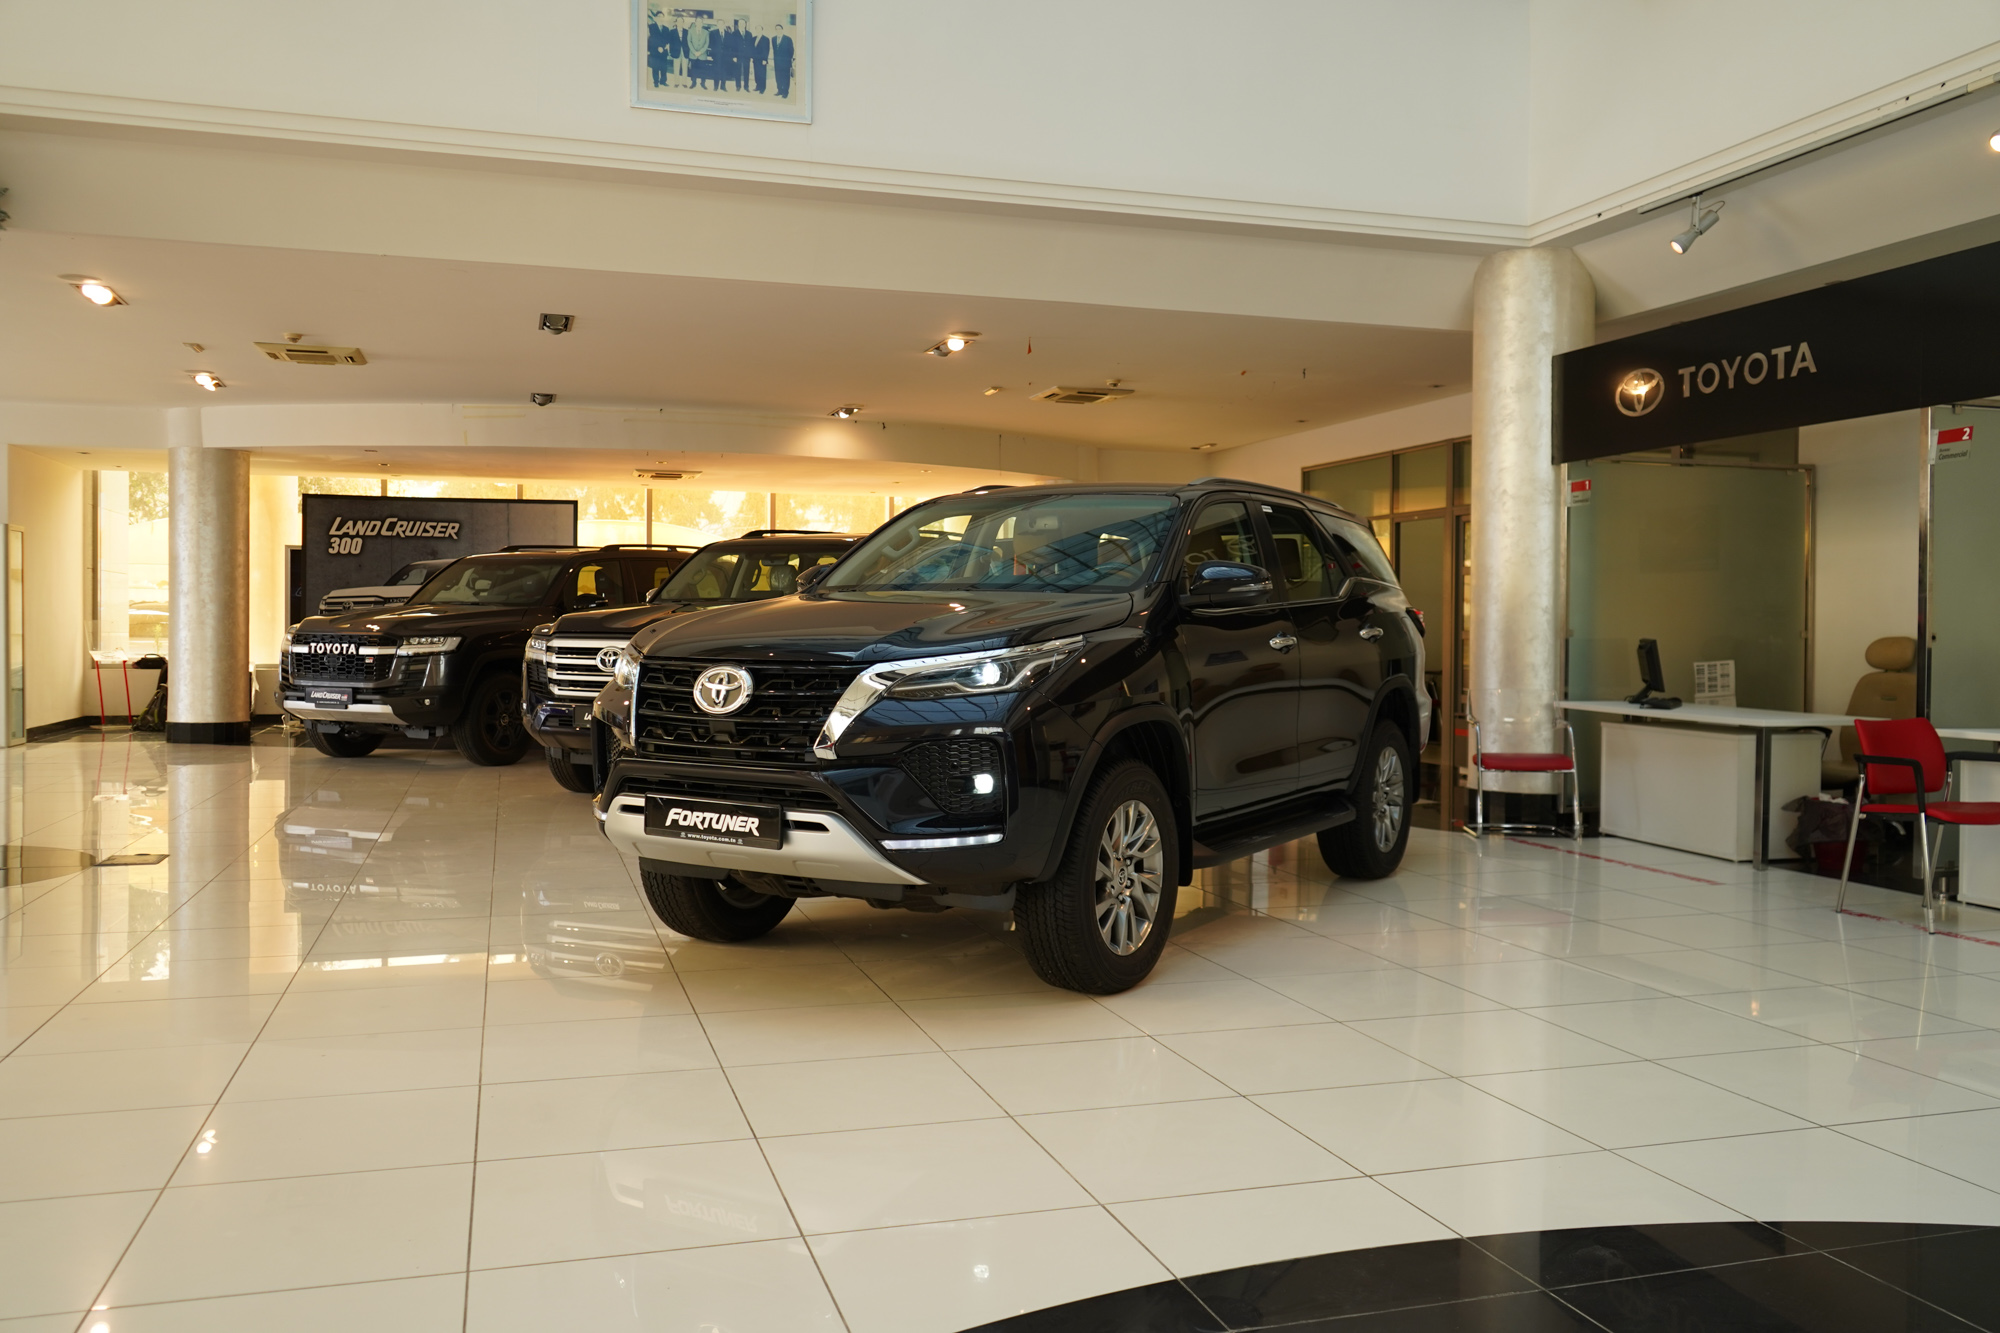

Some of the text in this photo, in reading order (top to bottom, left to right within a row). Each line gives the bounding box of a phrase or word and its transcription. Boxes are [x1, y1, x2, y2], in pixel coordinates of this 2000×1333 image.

[1678, 341, 1818, 398] TOYOTA
[1962, 427, 1971, 440] 2
[328, 516, 460, 540] LAND CRUISER
[328, 537, 363, 555] 300
[310, 642, 357, 655] TOYOTA
[583, 712, 592, 721] LA
[665, 807, 760, 837] FORTUNER
